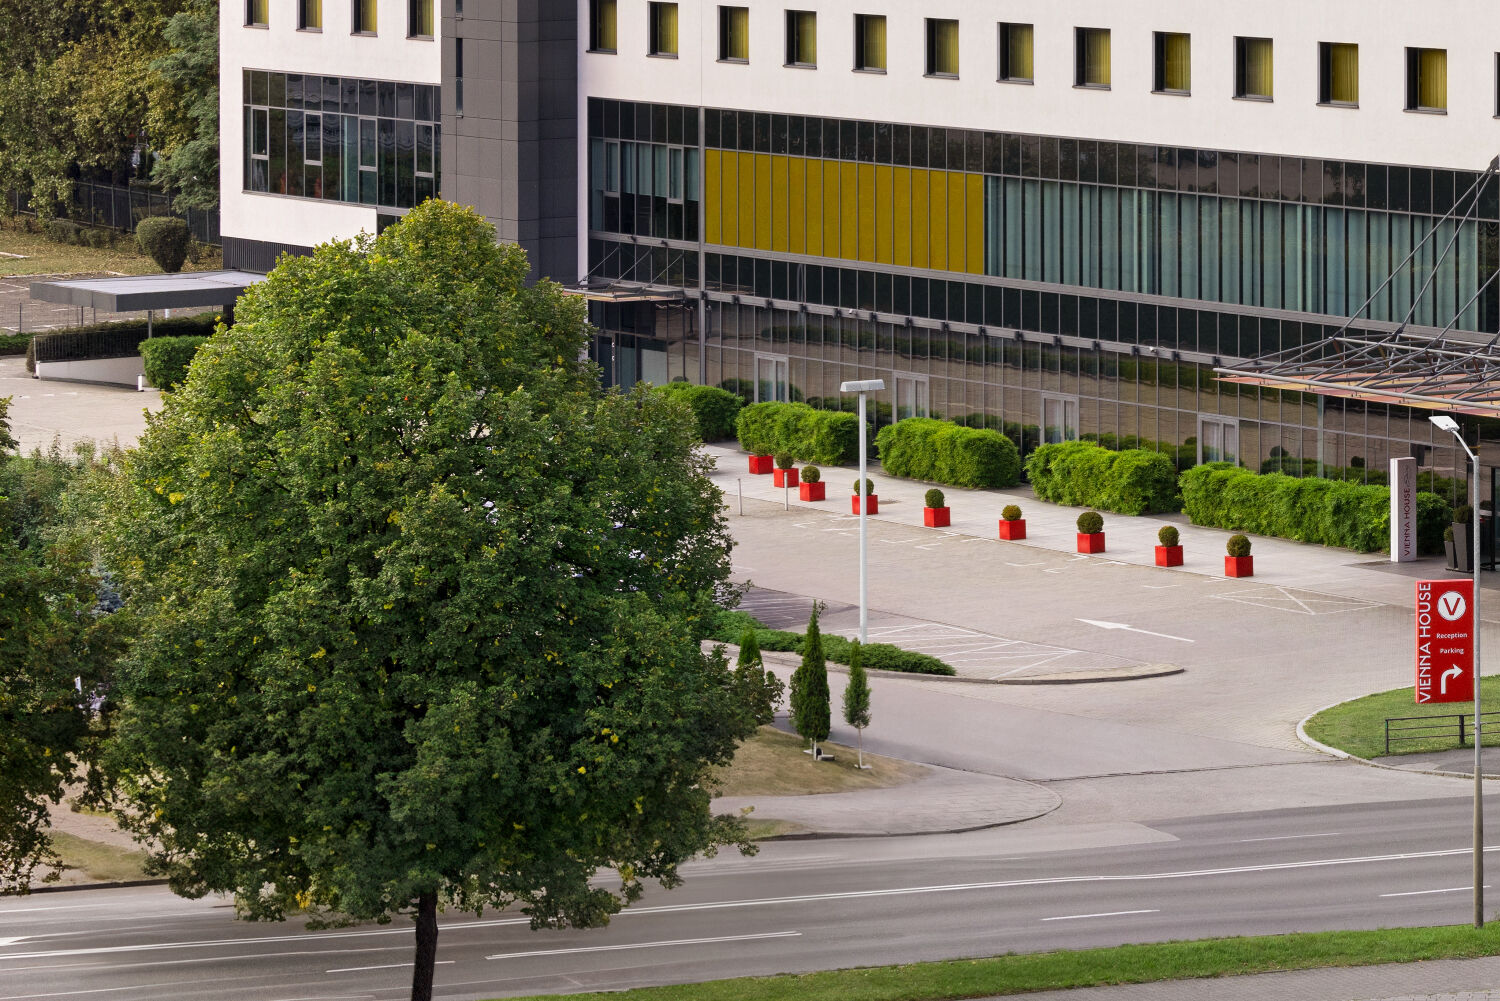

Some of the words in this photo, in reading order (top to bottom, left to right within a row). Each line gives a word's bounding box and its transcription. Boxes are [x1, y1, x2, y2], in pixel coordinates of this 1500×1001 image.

[1419, 583, 1431, 638] HOUSE
[1443, 597, 1461, 616] V
[1419, 642, 1431, 703] VIENNA
